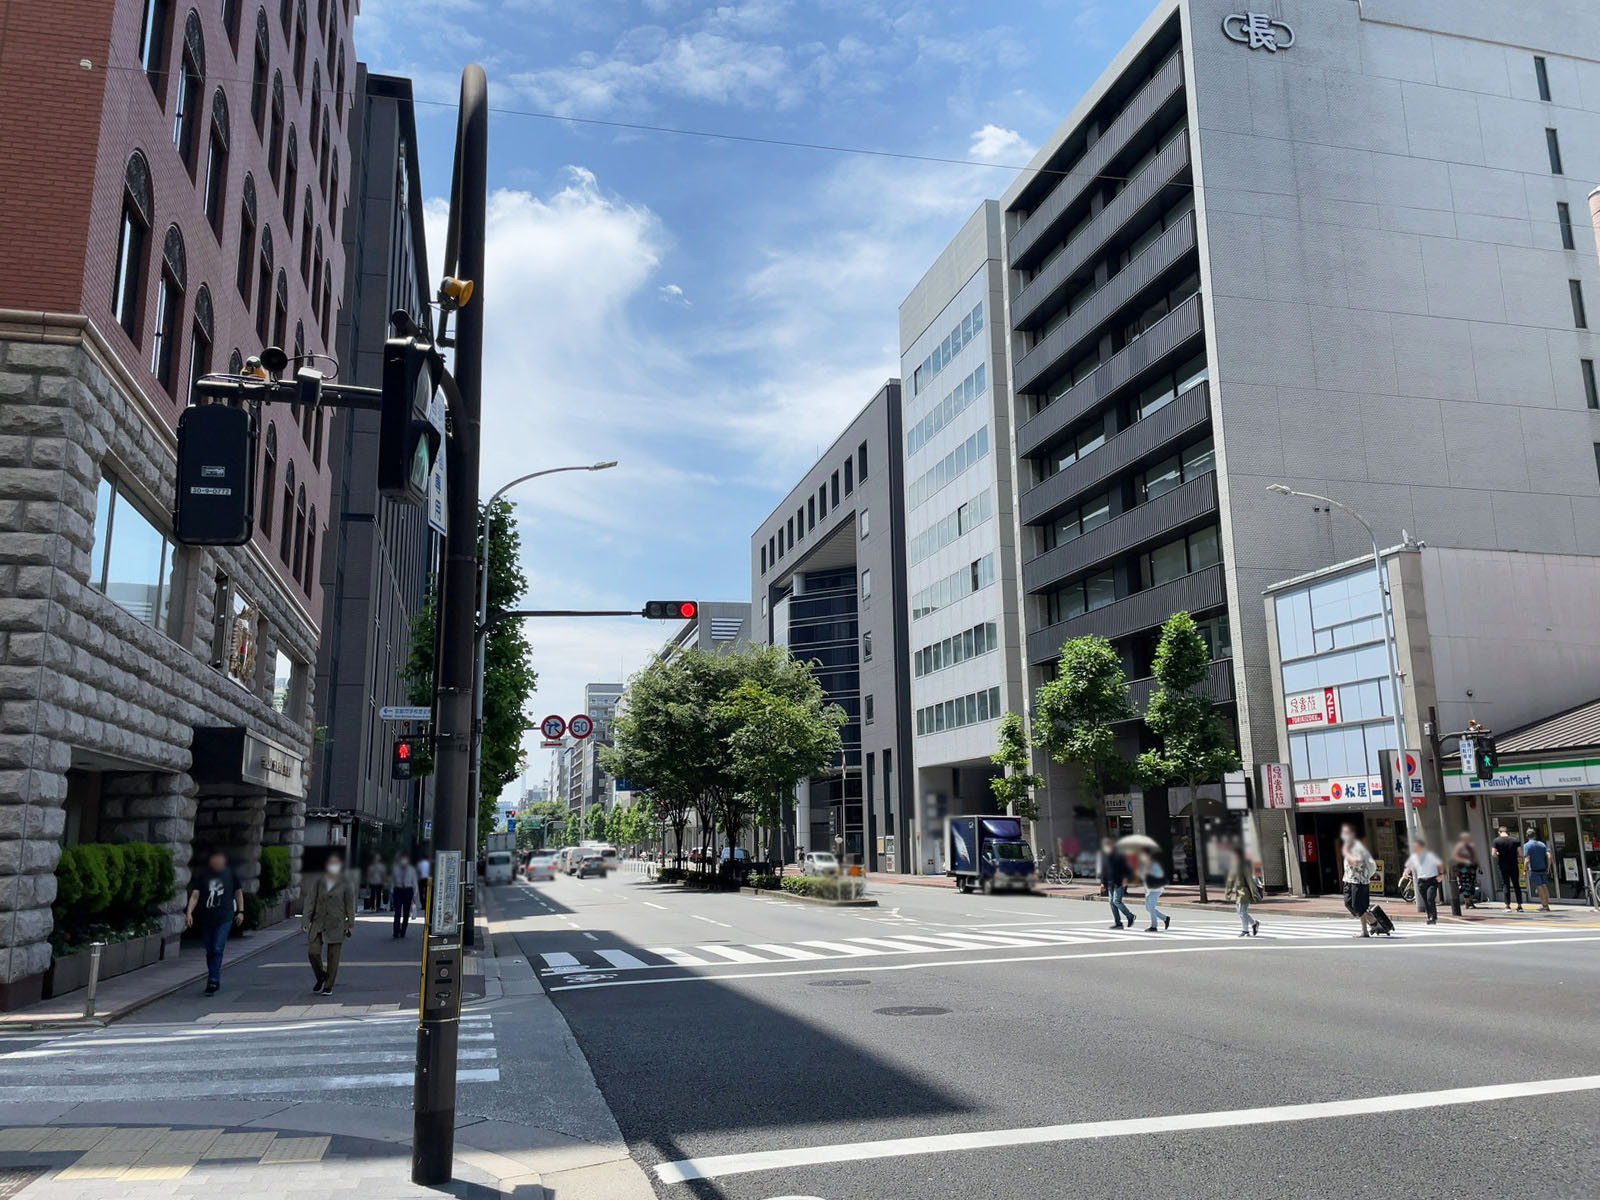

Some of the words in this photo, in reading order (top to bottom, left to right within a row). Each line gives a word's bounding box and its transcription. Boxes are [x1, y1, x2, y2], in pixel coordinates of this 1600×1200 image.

[1326, 693, 1335, 720] 2F
[573, 721, 588, 733] 50
[1483, 775, 1531, 788] FamilyMart
[1345, 782, 1367, 798] 松屋
